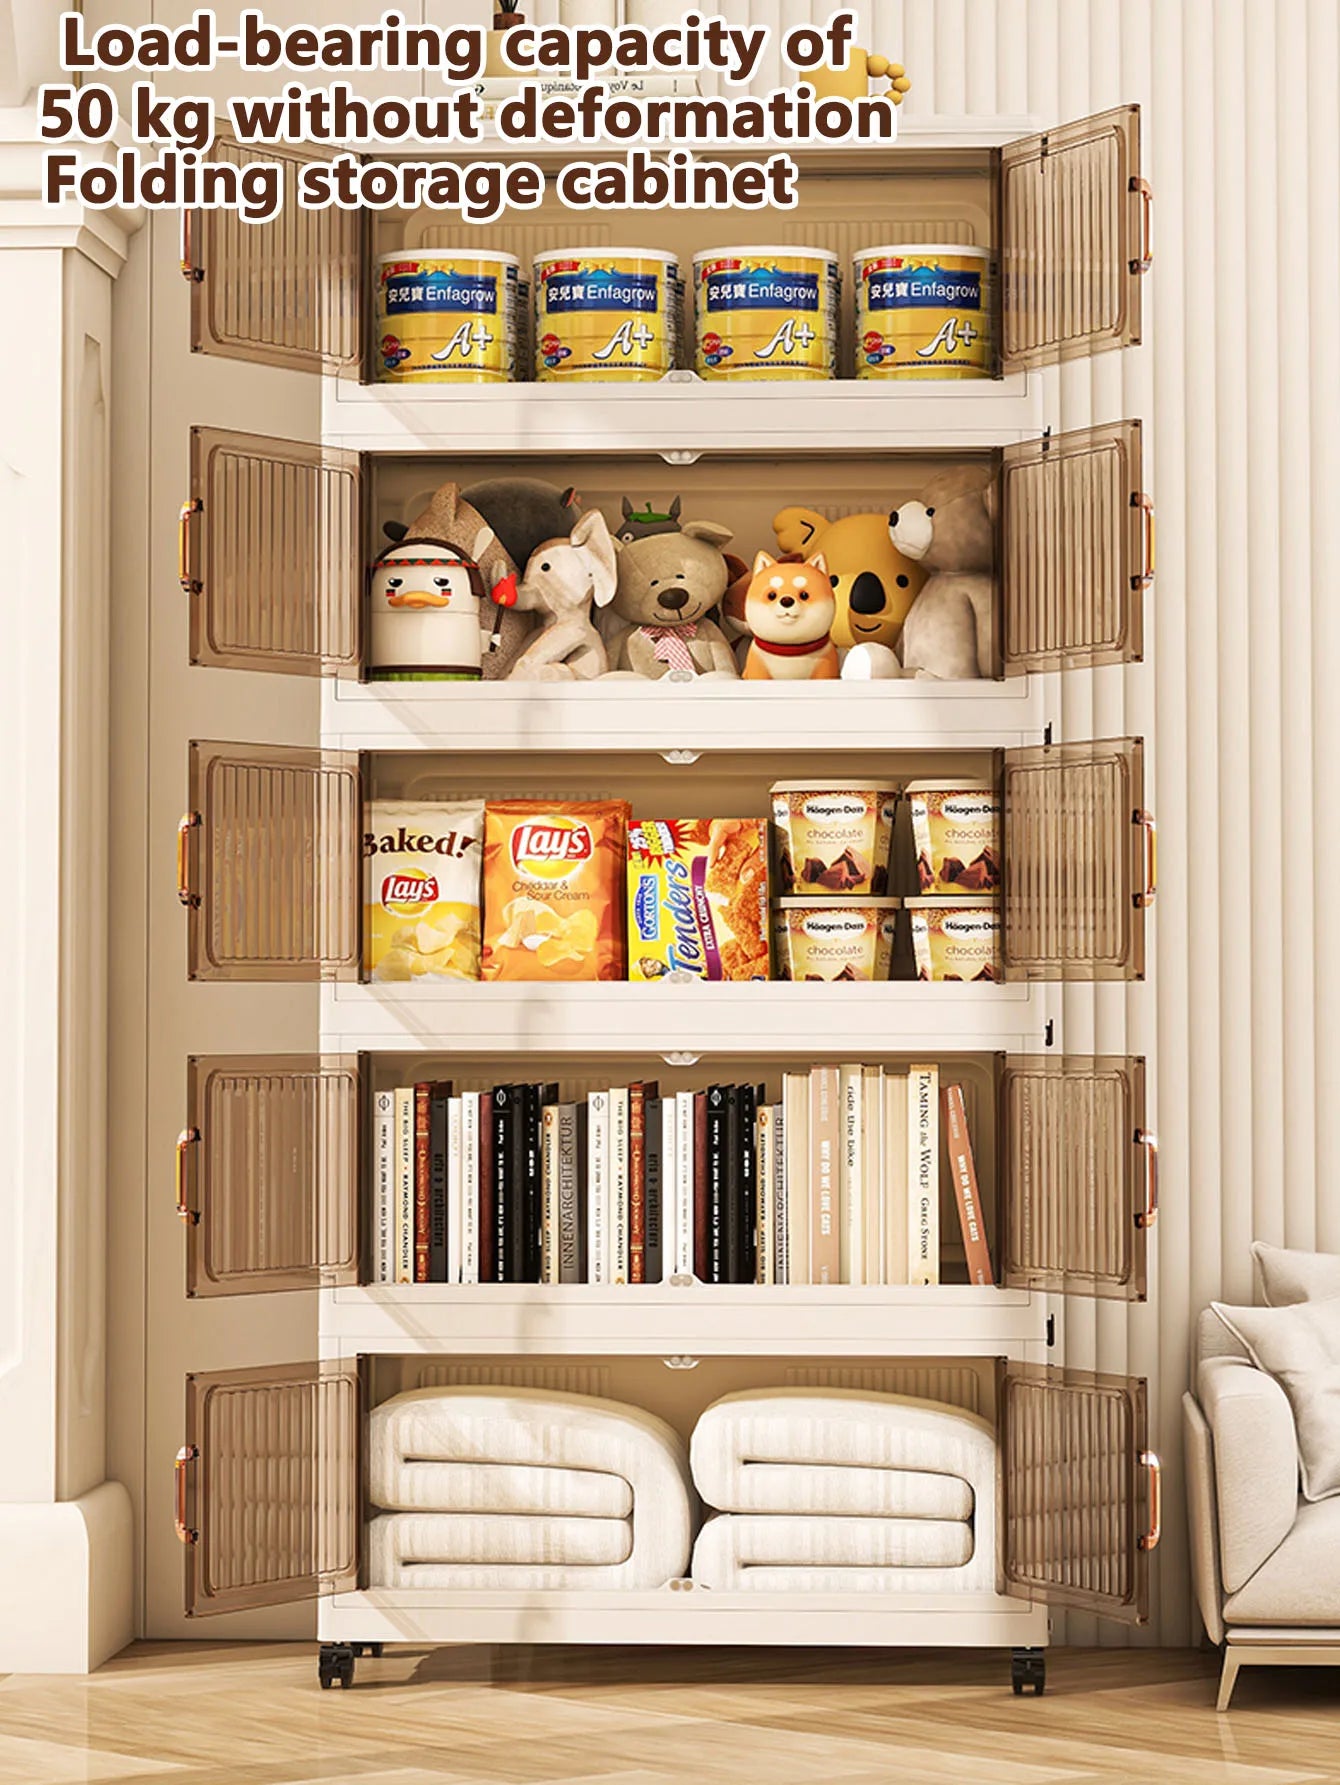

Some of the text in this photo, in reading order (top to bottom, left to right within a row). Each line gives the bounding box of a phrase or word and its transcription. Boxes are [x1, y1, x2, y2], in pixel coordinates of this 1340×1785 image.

[426, 286, 495, 304] Enfagrow
[586, 284, 656, 303] Enfagrow
[749, 283, 818, 301] Enfagrow
[911, 282, 980, 301] Enfagrow
[431, 321, 493, 360] A+
[592, 320, 654, 359] A+
[754, 319, 815, 357] A+
[916, 317, 977, 357] A+
[807, 828, 863, 839] chocolate
[512, 880, 558, 893] Cheddar
[526, 888, 590, 901] Sour Cream
[663, 859, 703, 973] Tenders
[807, 945, 863, 955] chocolate
[847, 1115, 855, 1136] the
[919, 1072, 932, 1189] TAMING the WOLF
[820, 1140, 831, 1160] WHY
[847, 1139, 855, 1167] bike
[820, 1162, 831, 1174] DO
[957, 1154, 967, 1173] WHY
[820, 1176, 831, 1190] WE
[960, 1174, 970, 1186] DO
[561, 1116, 574, 1270] INNENARCHITEKTUR
[965, 1201, 976, 1221] LOVE
[920, 1197, 930, 1260] GREG STONE
